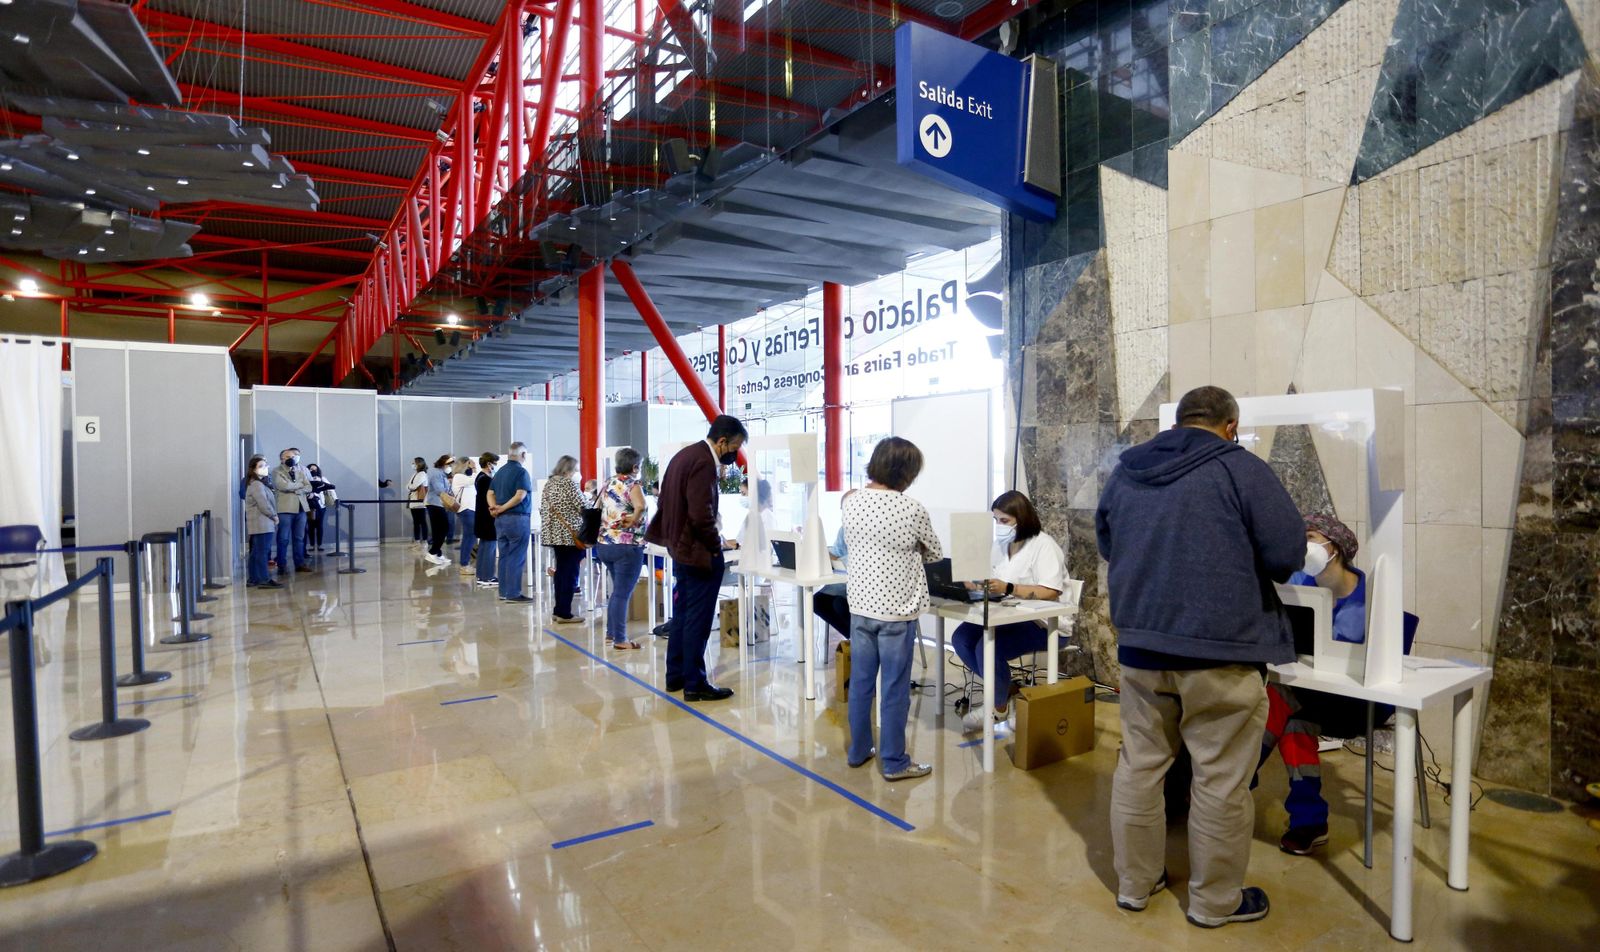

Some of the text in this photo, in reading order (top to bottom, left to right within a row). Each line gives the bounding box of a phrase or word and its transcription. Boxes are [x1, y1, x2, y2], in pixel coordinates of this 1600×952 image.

[919, 80, 993, 120] Salida Exit
[85, 421, 96, 435] 6
